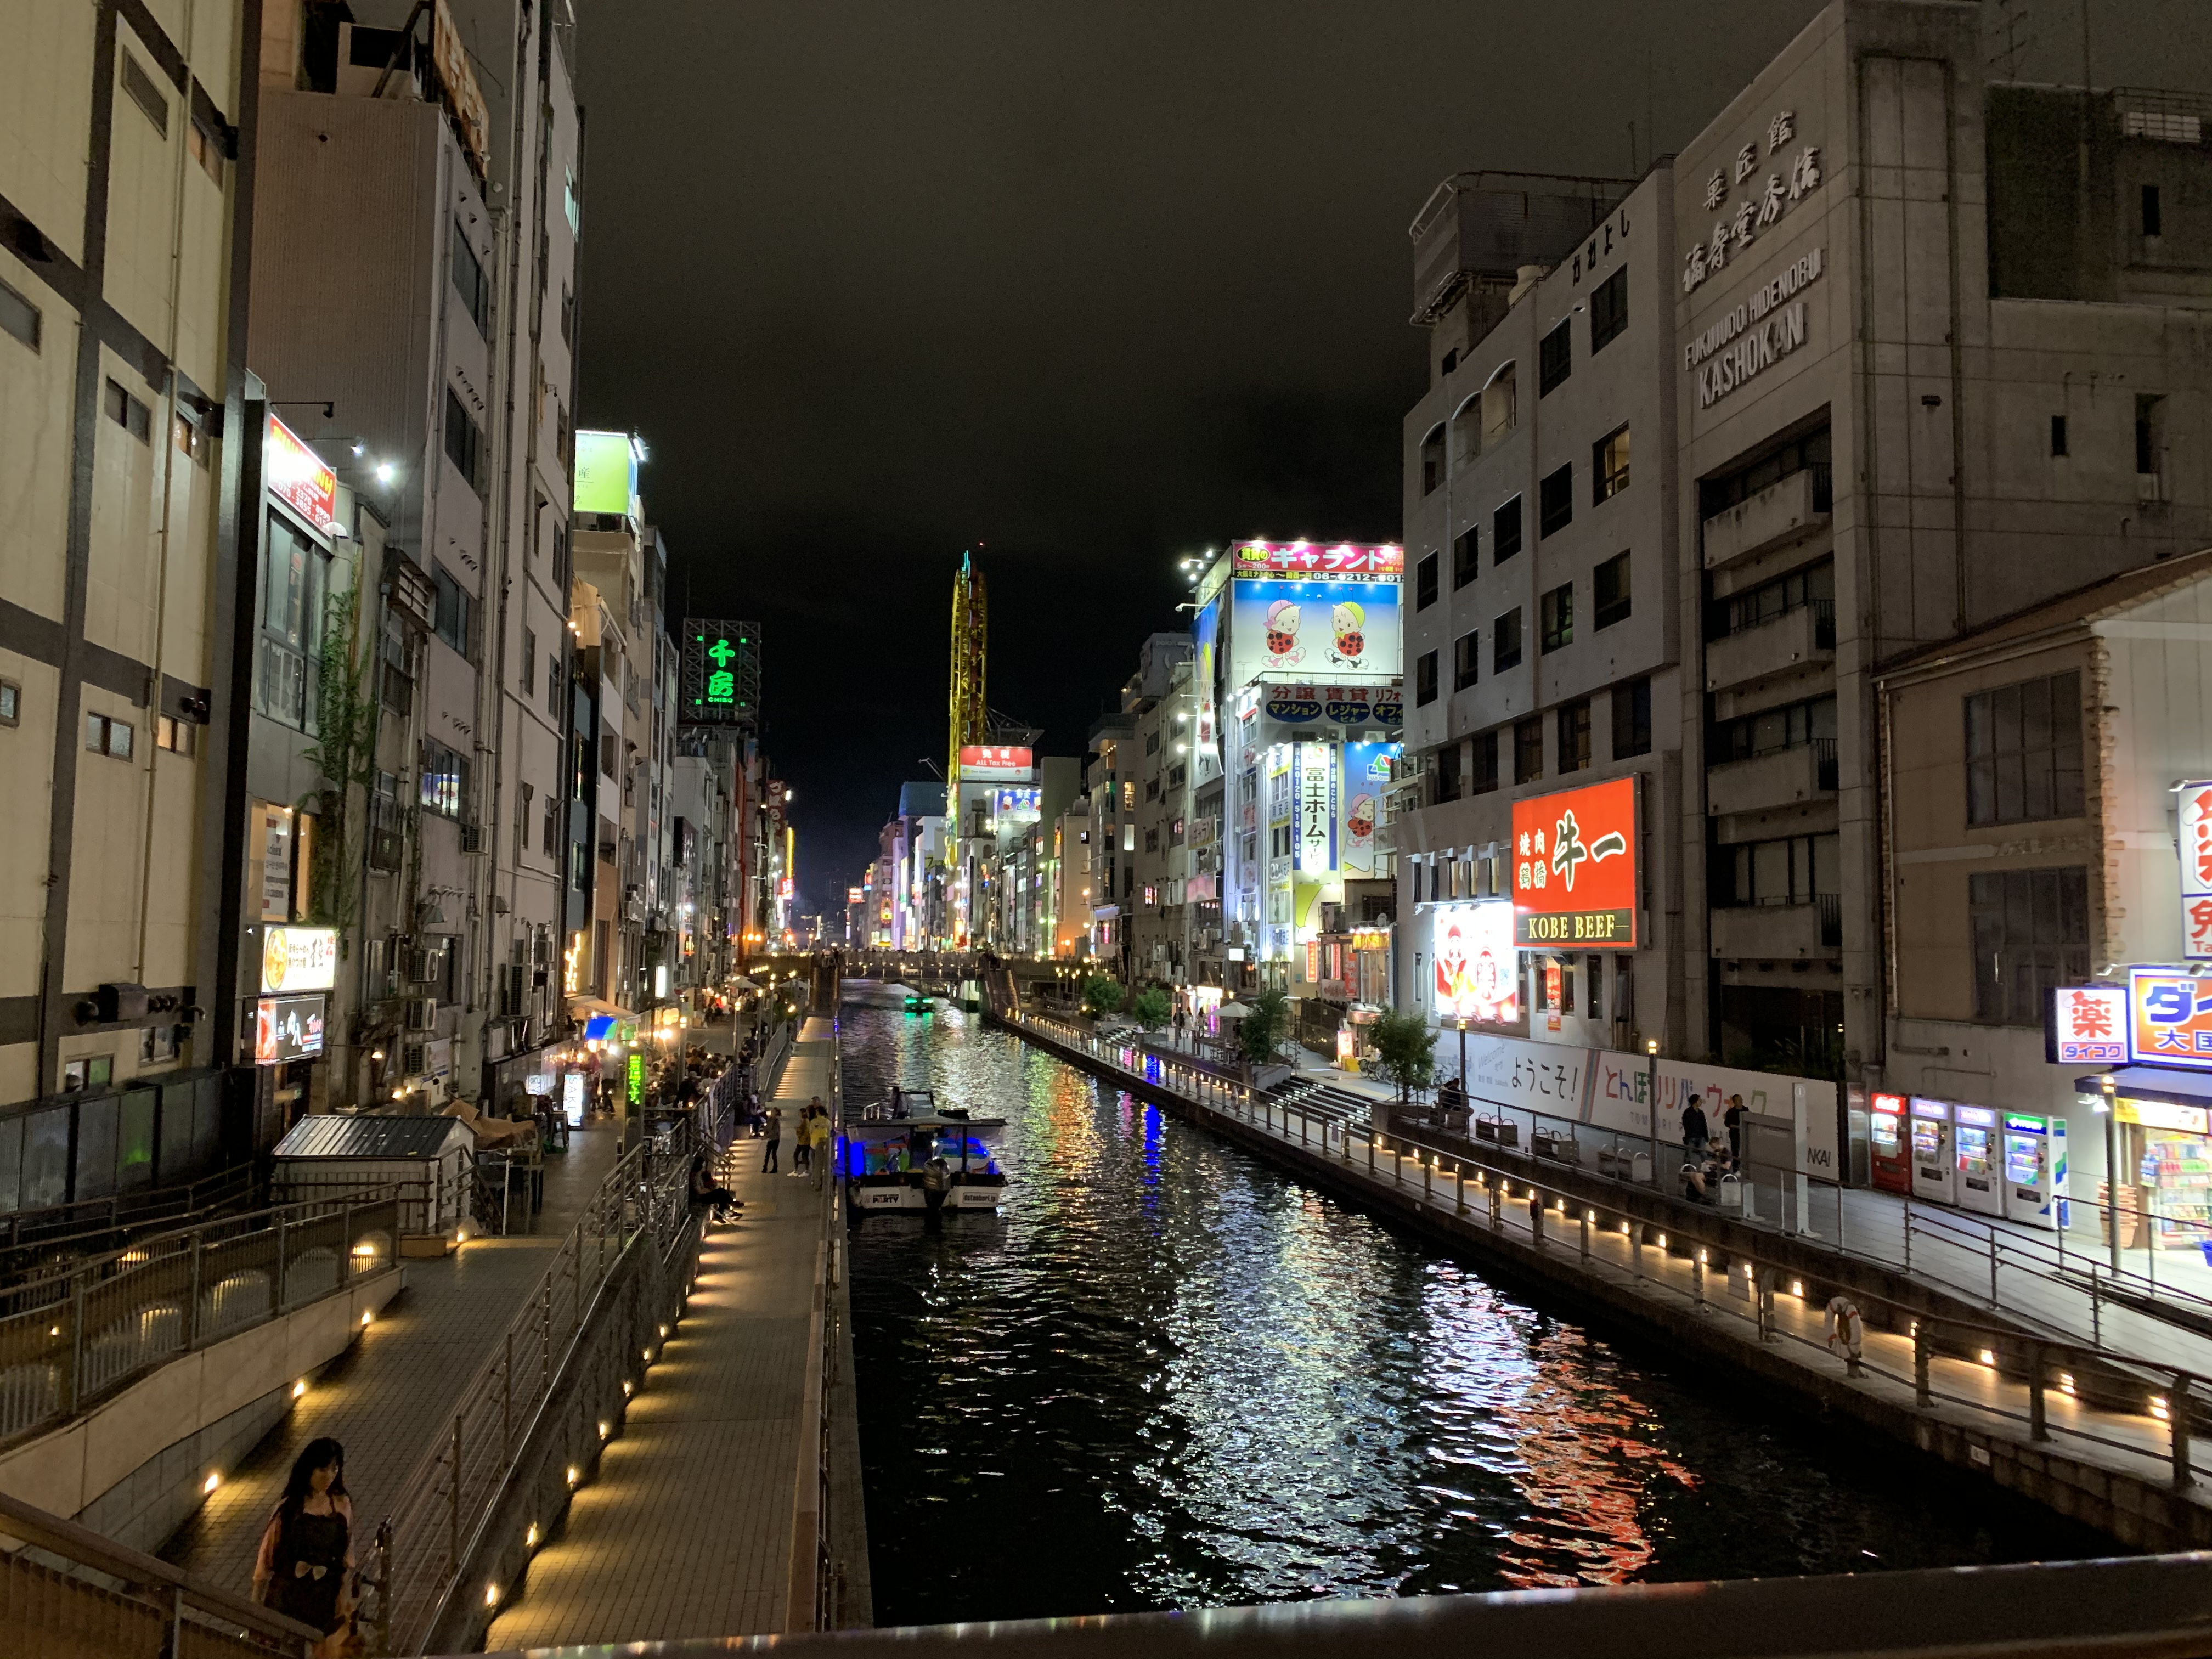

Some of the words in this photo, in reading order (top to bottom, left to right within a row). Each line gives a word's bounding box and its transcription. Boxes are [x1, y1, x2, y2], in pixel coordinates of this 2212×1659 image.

[1685, 304, 1745, 371] FUKUJUDO
[1749, 248, 1821, 324] HIDENOBU
[1700, 303, 1804, 409] KASHOKAN
[709, 639, 735, 696] 千房
[1272, 686, 1316, 700] 分譲
[1325, 687, 1369, 702] 賃貸
[1376, 689, 1403, 702] リフォ
[1269, 703, 1319, 716] マンション
[1329, 704, 1369, 716] レジャー
[1519, 828, 1545, 856] 焼肉
[1552, 809, 1626, 892] 牛一
[1528, 917, 1569, 939] KOBE
[1575, 915, 1615, 938] BEEF
[2193, 940, 2212, 953] Ta
[2064, 991, 2113, 1041] 薬
[2064, 1045, 2122, 1059] ダイコク
